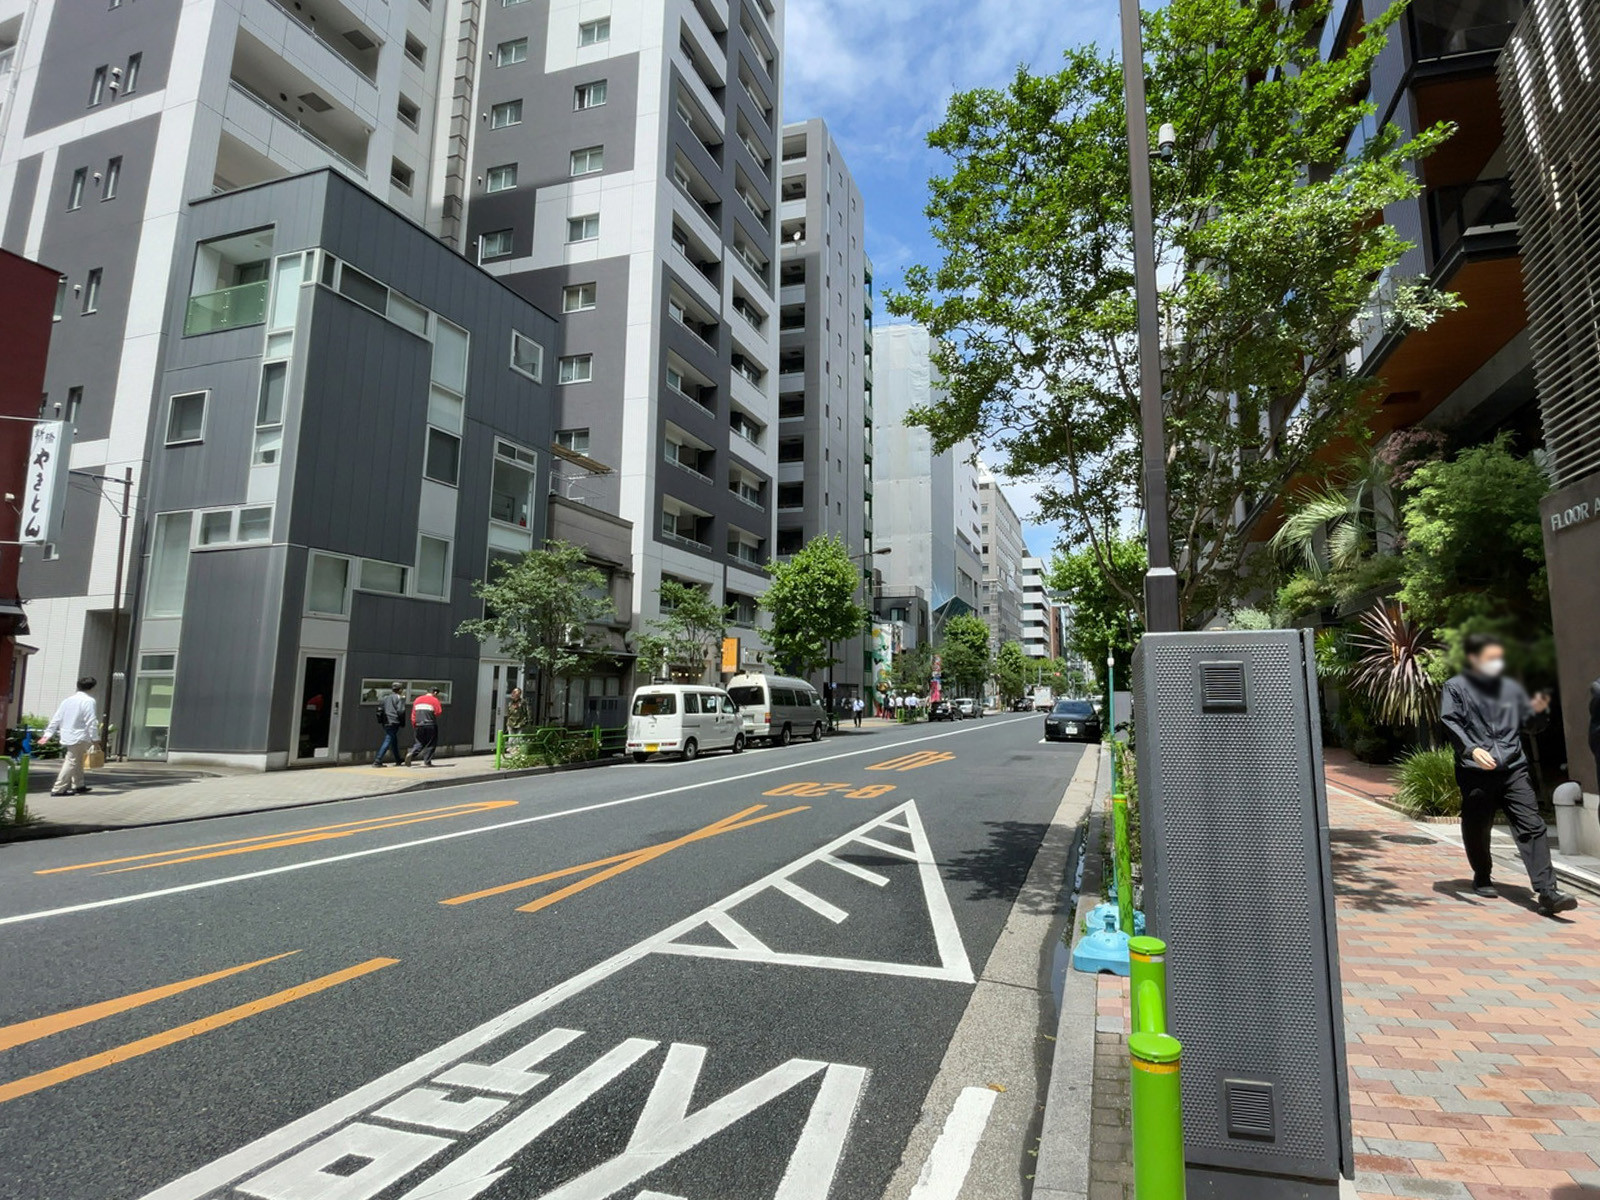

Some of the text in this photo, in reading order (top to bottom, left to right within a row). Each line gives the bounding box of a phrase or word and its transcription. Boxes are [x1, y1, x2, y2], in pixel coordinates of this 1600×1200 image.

[24, 448, 50, 538] やきとん
[1550, 502, 1589, 532] FLOOR
